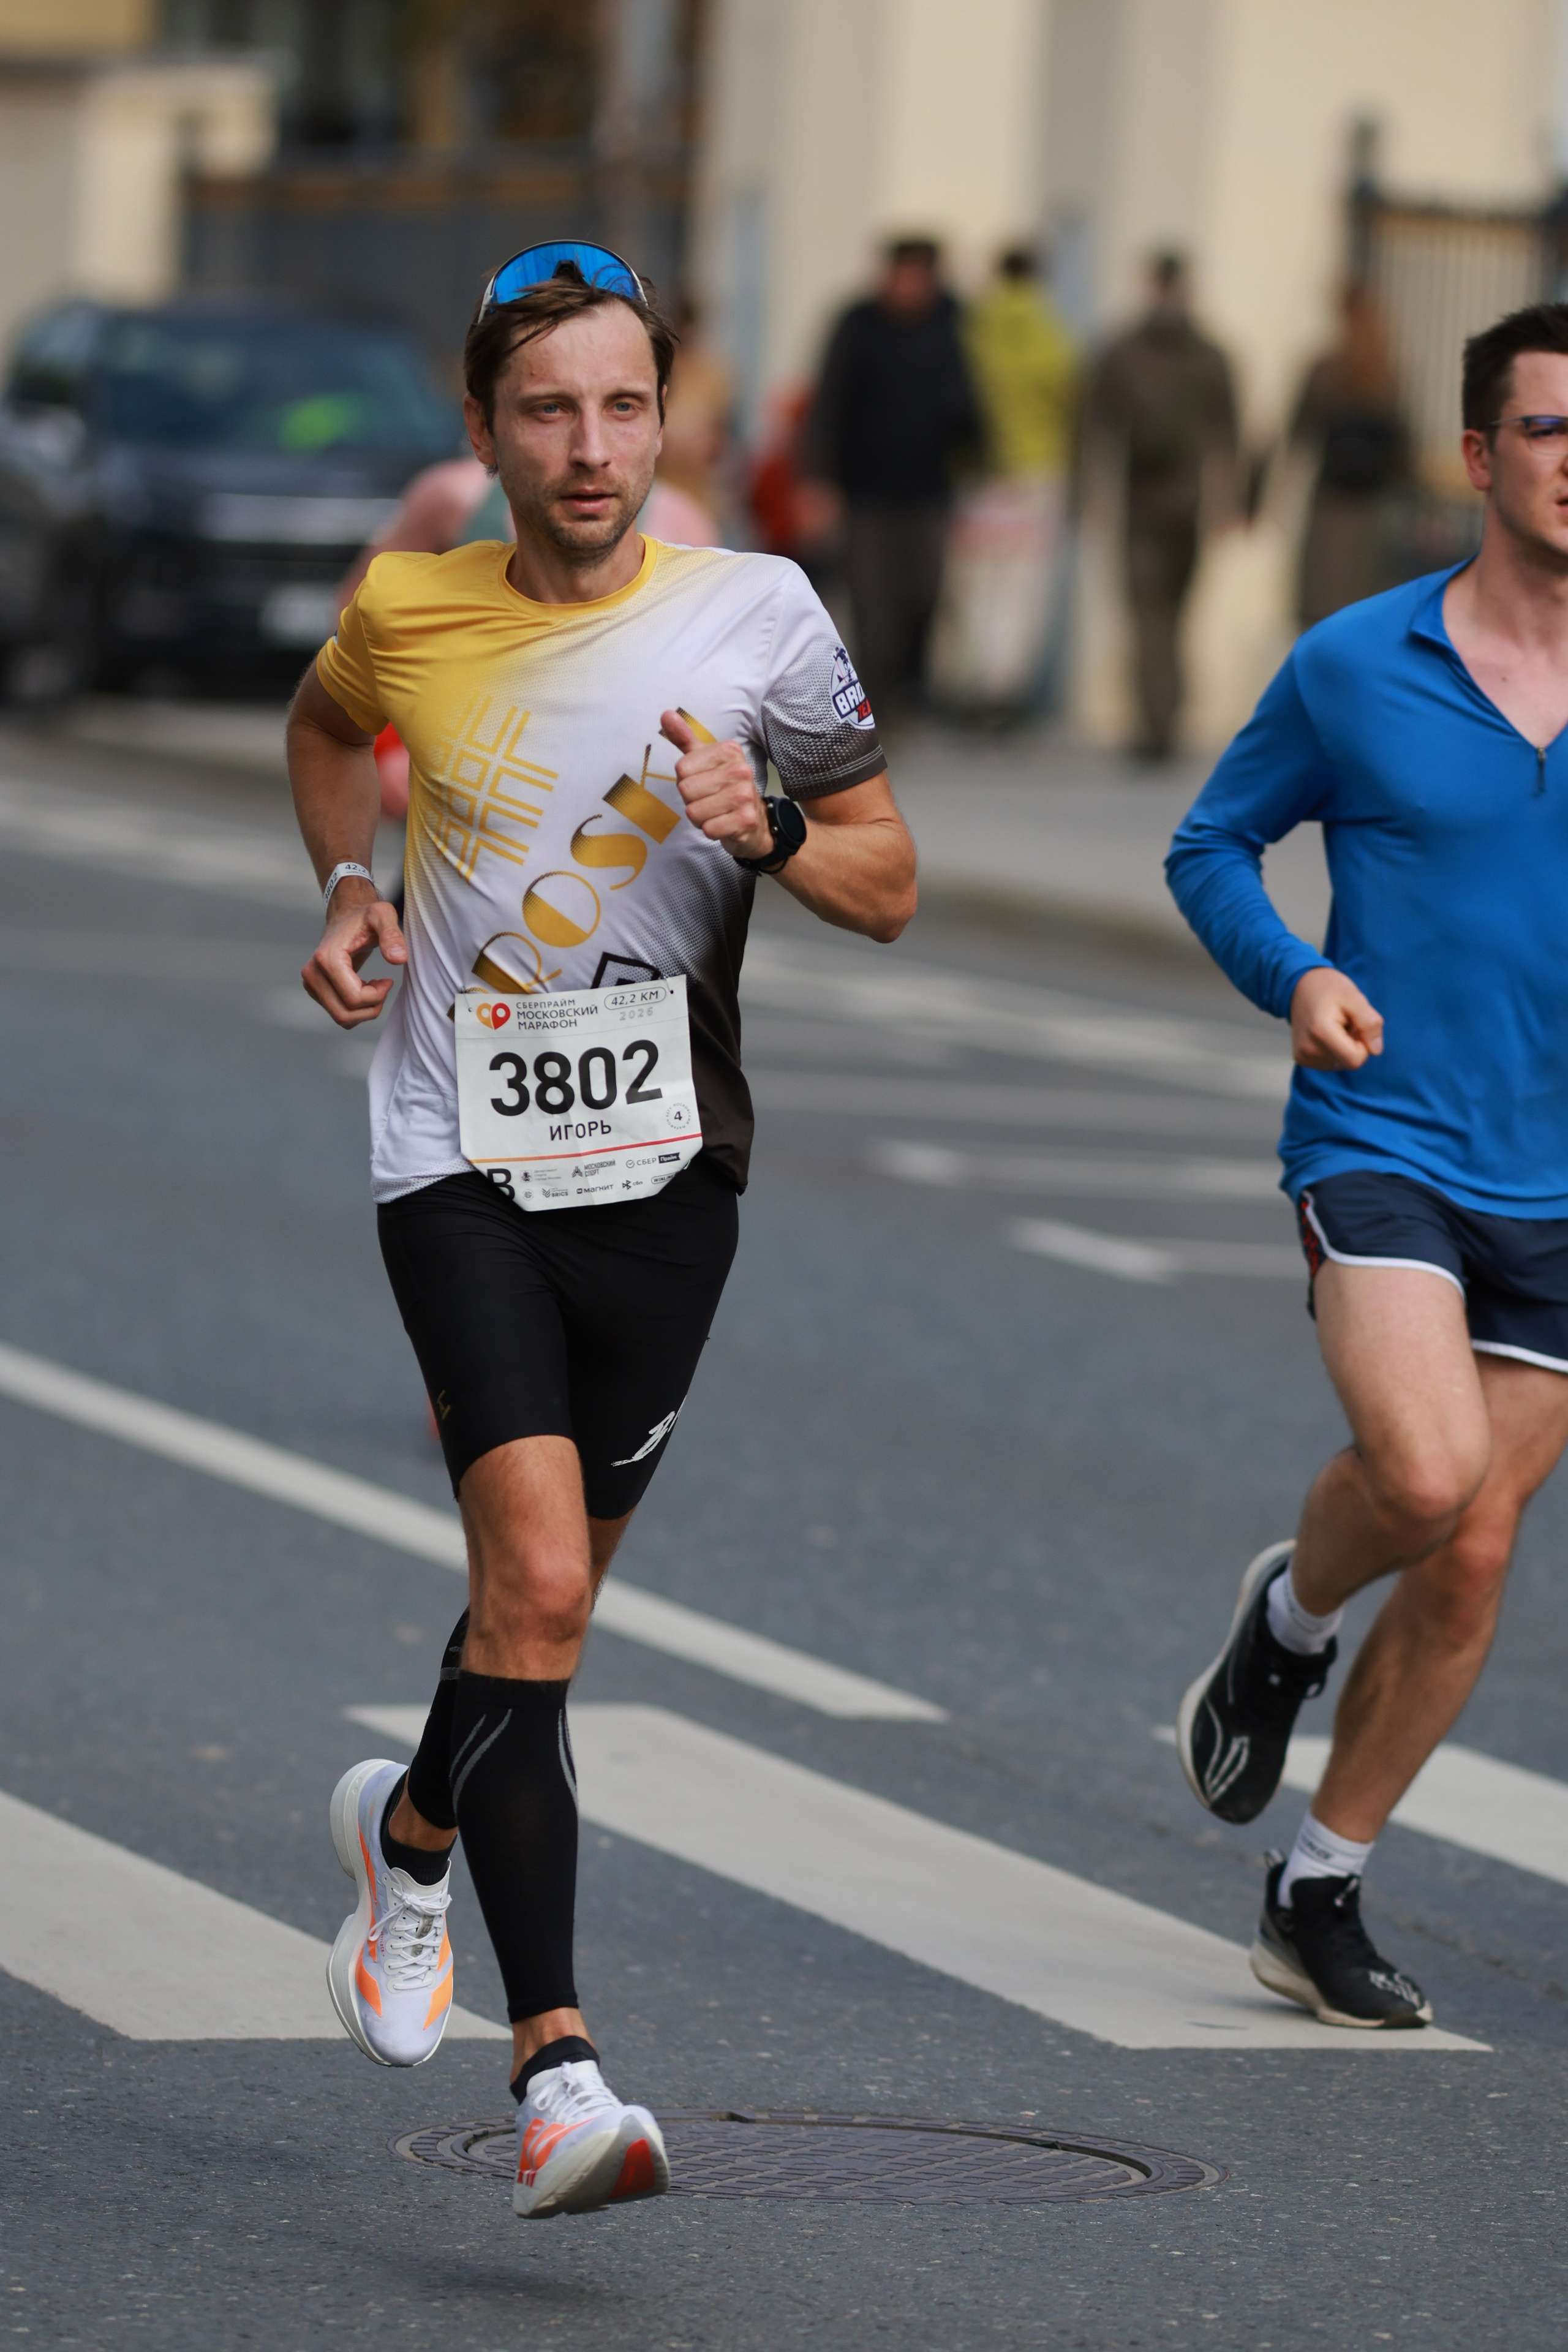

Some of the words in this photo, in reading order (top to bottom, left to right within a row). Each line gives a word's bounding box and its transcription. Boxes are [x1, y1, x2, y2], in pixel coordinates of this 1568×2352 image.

[516, 999, 575, 1009] СБЕРПРАЙМ
[611, 993, 636, 1006] 42,2
[517, 1005, 598, 1019] МОСКОВСКИЙ
[619, 1007, 654, 1021] 2026
[518, 1019, 577, 1030] МАРАФОН
[489, 1039, 663, 1117] 3802
[674, 1110, 682, 1121] 4
[549, 1120, 611, 1141] ИГОРЬ
[636, 1157, 657, 1166] СБЕР
